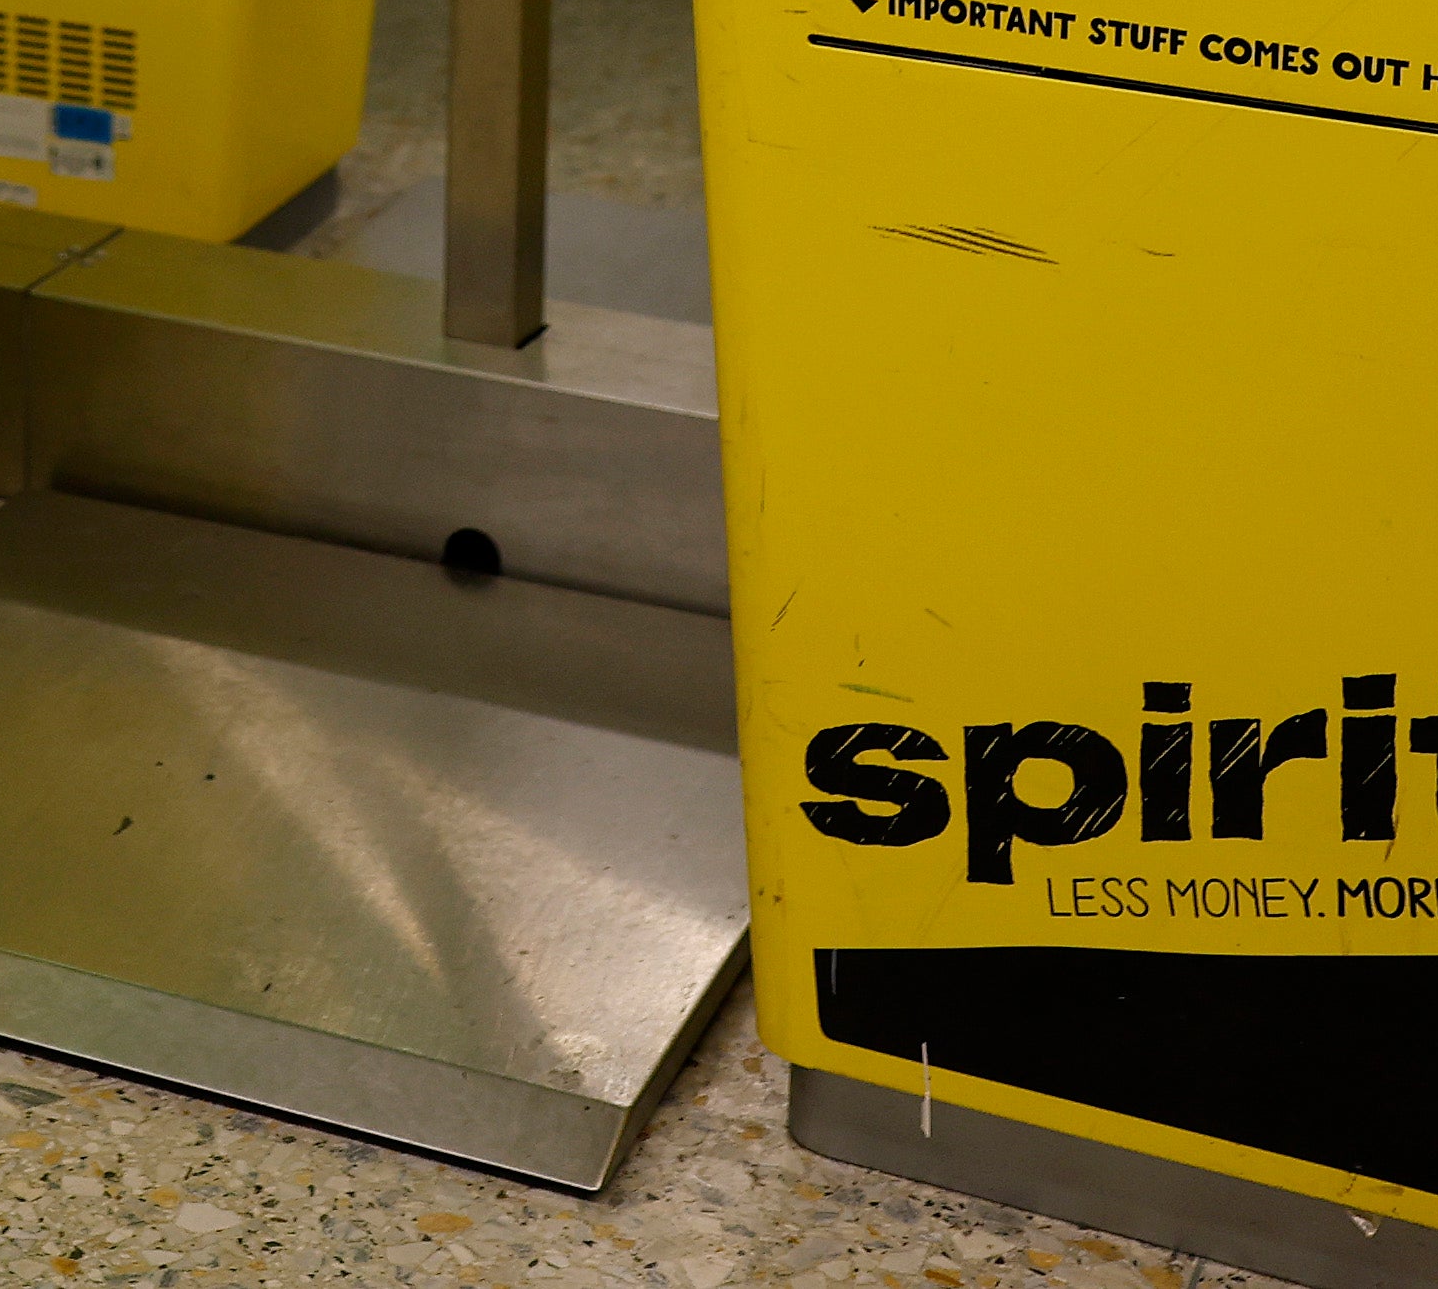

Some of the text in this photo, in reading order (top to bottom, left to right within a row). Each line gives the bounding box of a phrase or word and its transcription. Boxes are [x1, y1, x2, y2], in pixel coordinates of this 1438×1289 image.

[1088, 16, 1187, 57] STUFF
[1199, 32, 1320, 77] COMES
[1332, 50, 1410, 88] OUT
[1047, 876, 1150, 919] LESS
[1167, 876, 1327, 920] MONEY.
